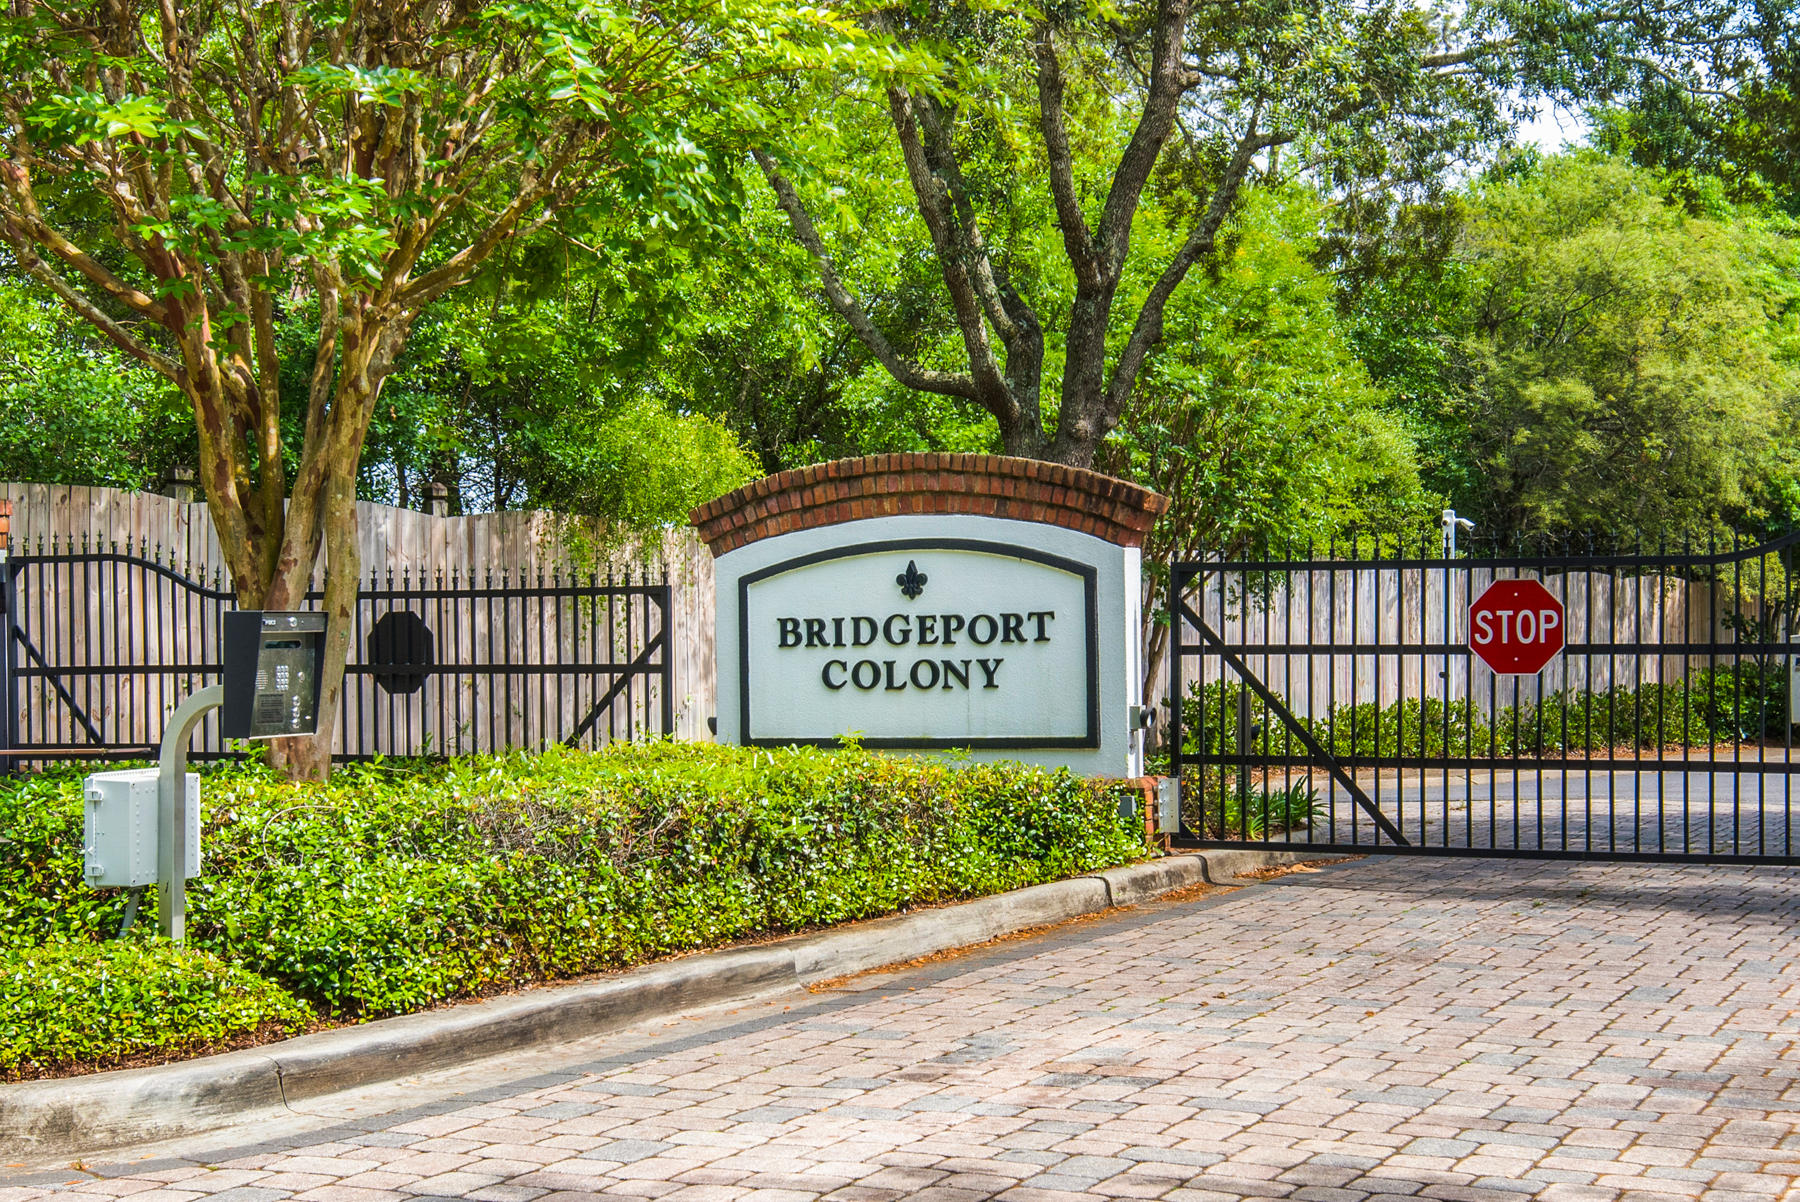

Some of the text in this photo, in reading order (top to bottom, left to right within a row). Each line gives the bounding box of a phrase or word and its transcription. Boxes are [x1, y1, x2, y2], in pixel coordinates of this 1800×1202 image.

[777, 611, 1055, 648] BRIDGEPORT
[1474, 609, 1559, 645] STOP
[821, 658, 1004, 691] COLONY
